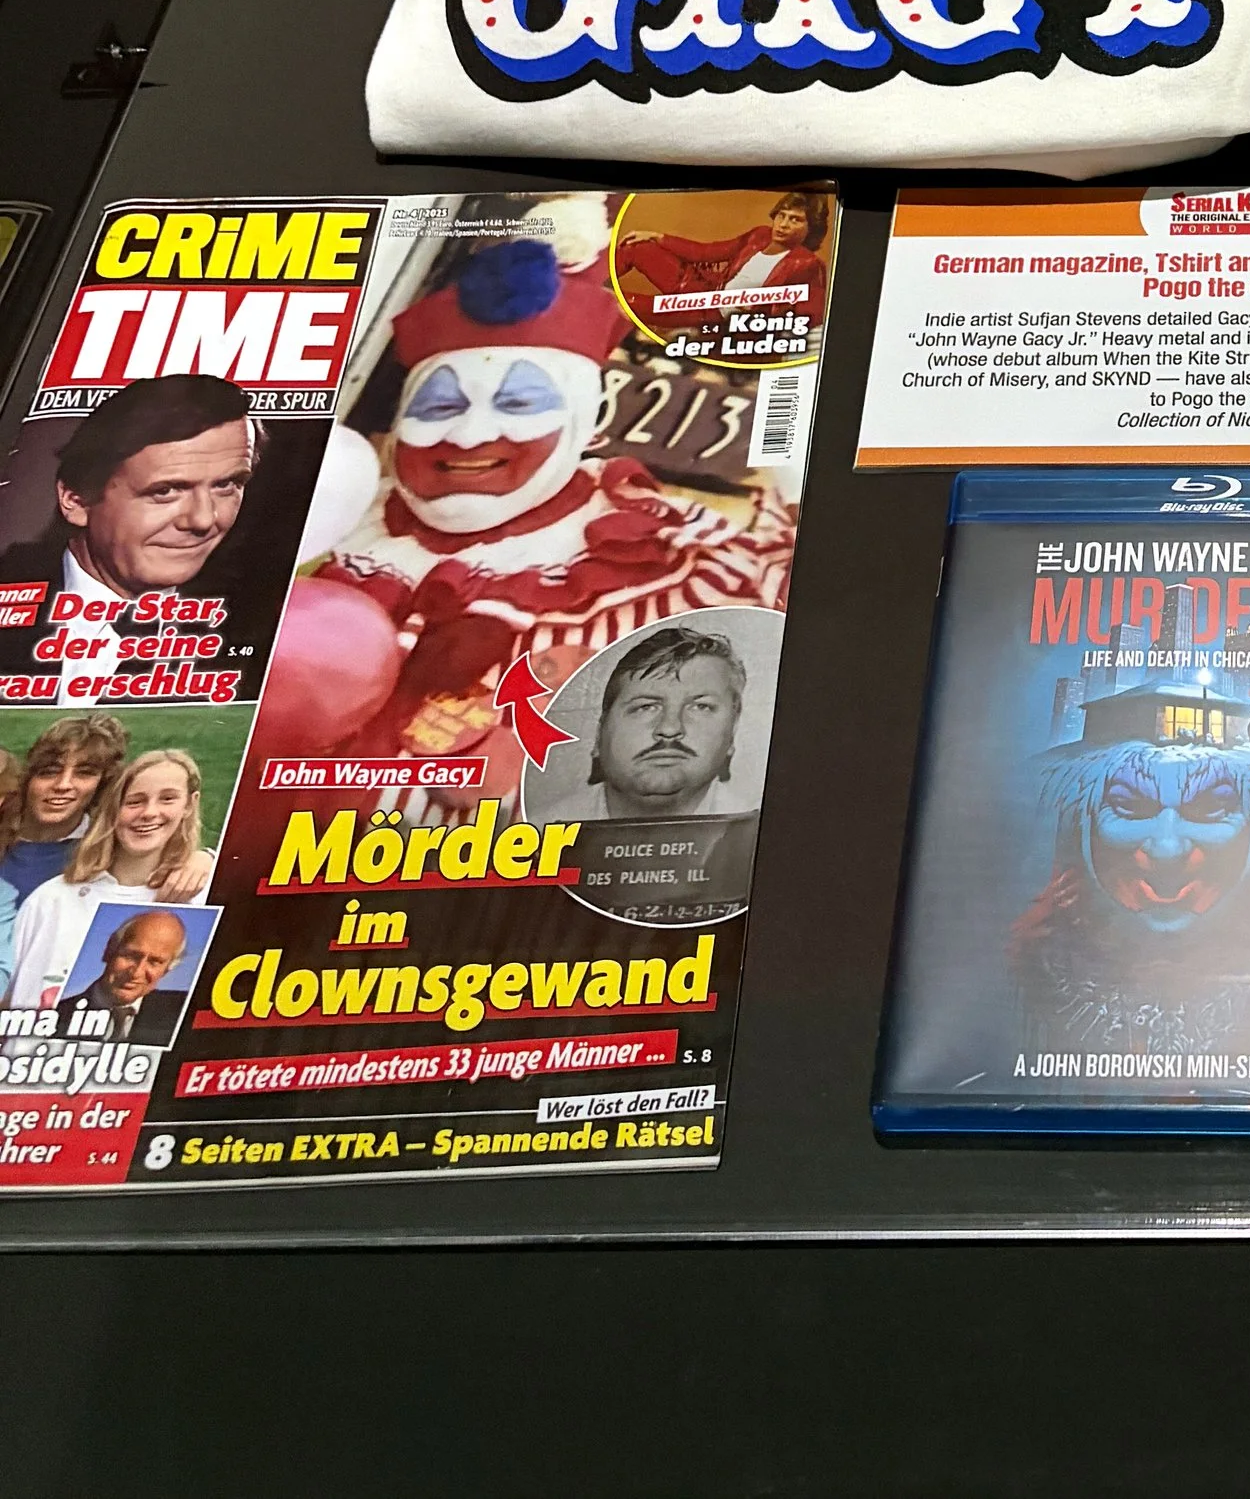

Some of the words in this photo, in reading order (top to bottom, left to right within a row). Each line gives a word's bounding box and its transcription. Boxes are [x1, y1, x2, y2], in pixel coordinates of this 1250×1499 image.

[934, 254, 1023, 273] German
[1029, 253, 1149, 275] magazine,
[1156, 252, 1222, 272] Tshirt
[659, 295, 706, 311] Klaus
[710, 287, 804, 308] Barkowsky
[1144, 278, 1201, 300] Pogo
[1208, 278, 1245, 297] the
[729, 311, 810, 336] König
[926, 313, 965, 327] Indie
[970, 313, 1012, 327] artist
[1018, 312, 1070, 329] Sufjan
[1076, 312, 1141, 326] Stevens
[1147, 311, 1212, 326] detailed
[71, 289, 350, 383] TIME
[665, 336, 715, 358] der
[721, 334, 807, 355] Luden
[909, 332, 956, 347] “John
[962, 332, 1016, 349] Wayne
[1022, 332, 1063, 349] Gacy
[1068, 332, 1097, 346] Jr.”
[1102, 332, 1152, 348] Heavy
[1158, 331, 1204, 345] metal
[1210, 330, 1240, 345] and
[927, 352, 987, 369] (whose
[993, 352, 1041, 366] debut
[1046, 352, 1097, 366] album
[1104, 352, 1150, 366] When
[1156, 351, 1182, 366] the
[1188, 351, 1220, 365] Kite
[902, 372, 962, 388] Church
[968, 372, 984, 387] of
[990, 372, 1050, 390] Misery,
[1055, 372, 1086, 386] and
[1092, 371, 1150, 386] SKYND
[1186, 371, 1225, 386] have
[40, 390, 82, 409] DEM
[281, 393, 328, 410] SPUR
[1150, 392, 1166, 406] to
[1172, 392, 1214, 409] Pogo
[1219, 391, 1246, 406] the
[1117, 412, 1200, 428] Collection
[1206, 412, 1225, 428] of
[1211, 501, 1245, 511] Disc
[1037, 541, 1063, 574] THE
[1064, 542, 1146, 574] JOHN
[1152, 542, 1249, 574] WAYNE
[50, 592, 132, 623] Der
[134, 589, 228, 628] Star,
[35, 628, 111, 661] der
[116, 629, 222, 660] seine
[1084, 651, 1112, 669] LIFE
[1115, 651, 1146, 668] AND
[1147, 651, 1192, 668] DEATH
[1195, 651, 1208, 668] IN
[66, 663, 241, 703] erschlug
[269, 764, 335, 788] John
[338, 761, 413, 787] Wayne
[417, 760, 476, 788] Gacy
[268, 799, 581, 887] Mörder
[605, 843, 654, 858] POLICE
[660, 842, 698, 856] DEPT.
[587, 873, 611, 886] DES
[620, 870, 678, 885] PLAINES,
[336, 899, 408, 946] im
[210, 934, 716, 1032] Clownsgewand
[67, 998, 111, 1036] in
[184, 1066, 212, 1093] Er
[217, 1061, 296, 1091] tötete
[299, 1050, 442, 1087] mindestens
[445, 1047, 469, 1076] 33
[472, 1046, 543, 1084] junge
[548, 1038, 643, 1069] Männer
[1014, 1054, 1026, 1077] A
[1030, 1054, 1081, 1077] JOHN
[1085, 1054, 1182, 1078] BOROWSKI
[46, 1104, 73, 1130] in
[80, 1101, 131, 1130] der
[545, 1096, 586, 1120] Wer
[589, 1093, 624, 1116] löst
[626, 1092, 663, 1113] den
[665, 1088, 709, 1111] Fall?
[144, 1133, 176, 1171] 8
[181, 1135, 284, 1165] Seiten
[290, 1131, 400, 1161] EXTRA
[432, 1119, 607, 1155] Spannende
[614, 1115, 715, 1149] Rätsel
